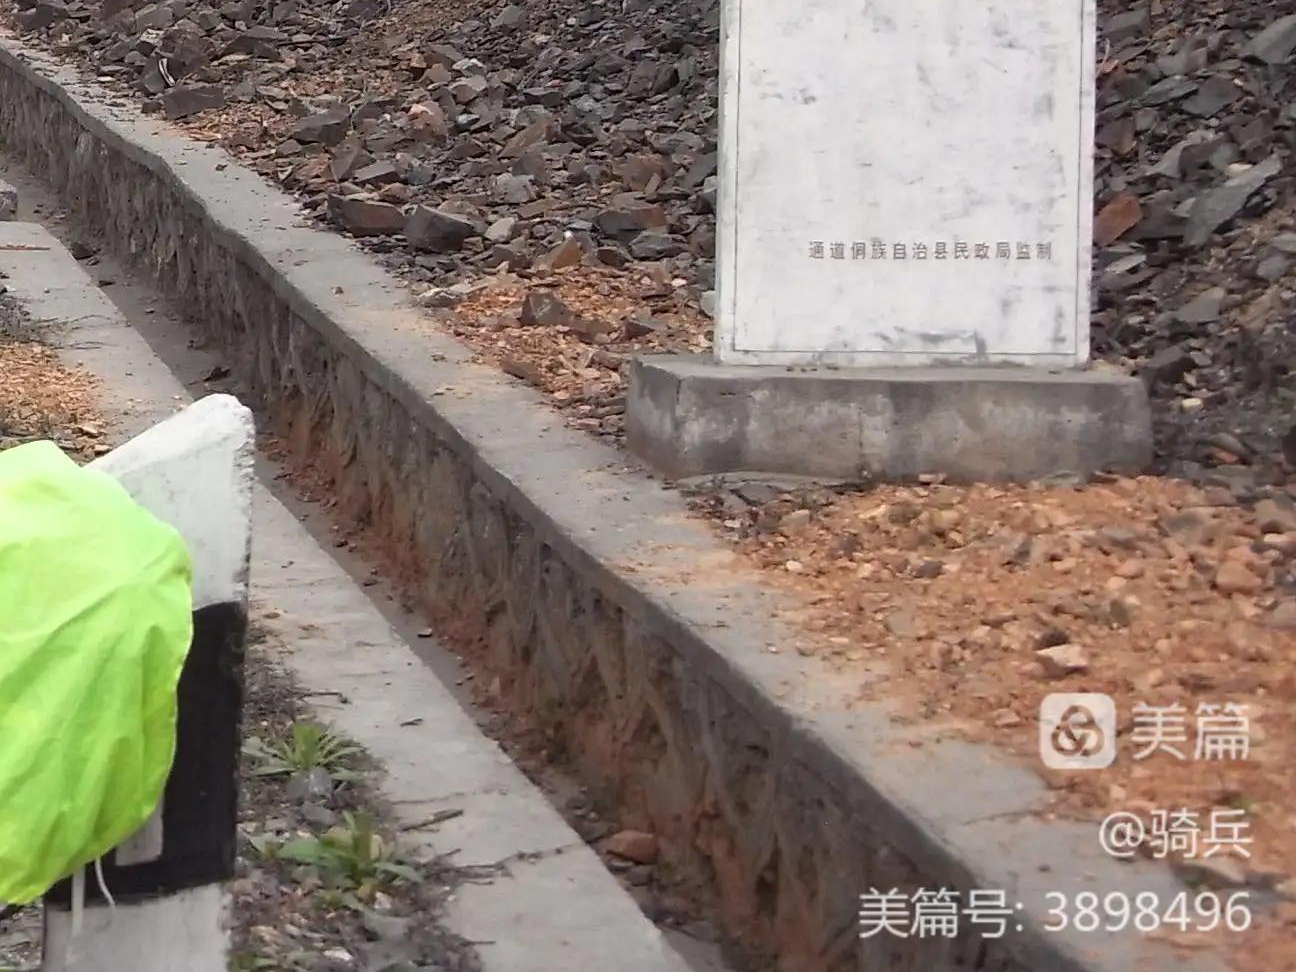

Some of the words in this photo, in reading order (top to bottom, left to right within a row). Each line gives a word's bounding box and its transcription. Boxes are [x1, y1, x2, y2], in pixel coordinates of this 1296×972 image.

[808, 240, 1053, 261] 通道侗族自治县民政局监制
